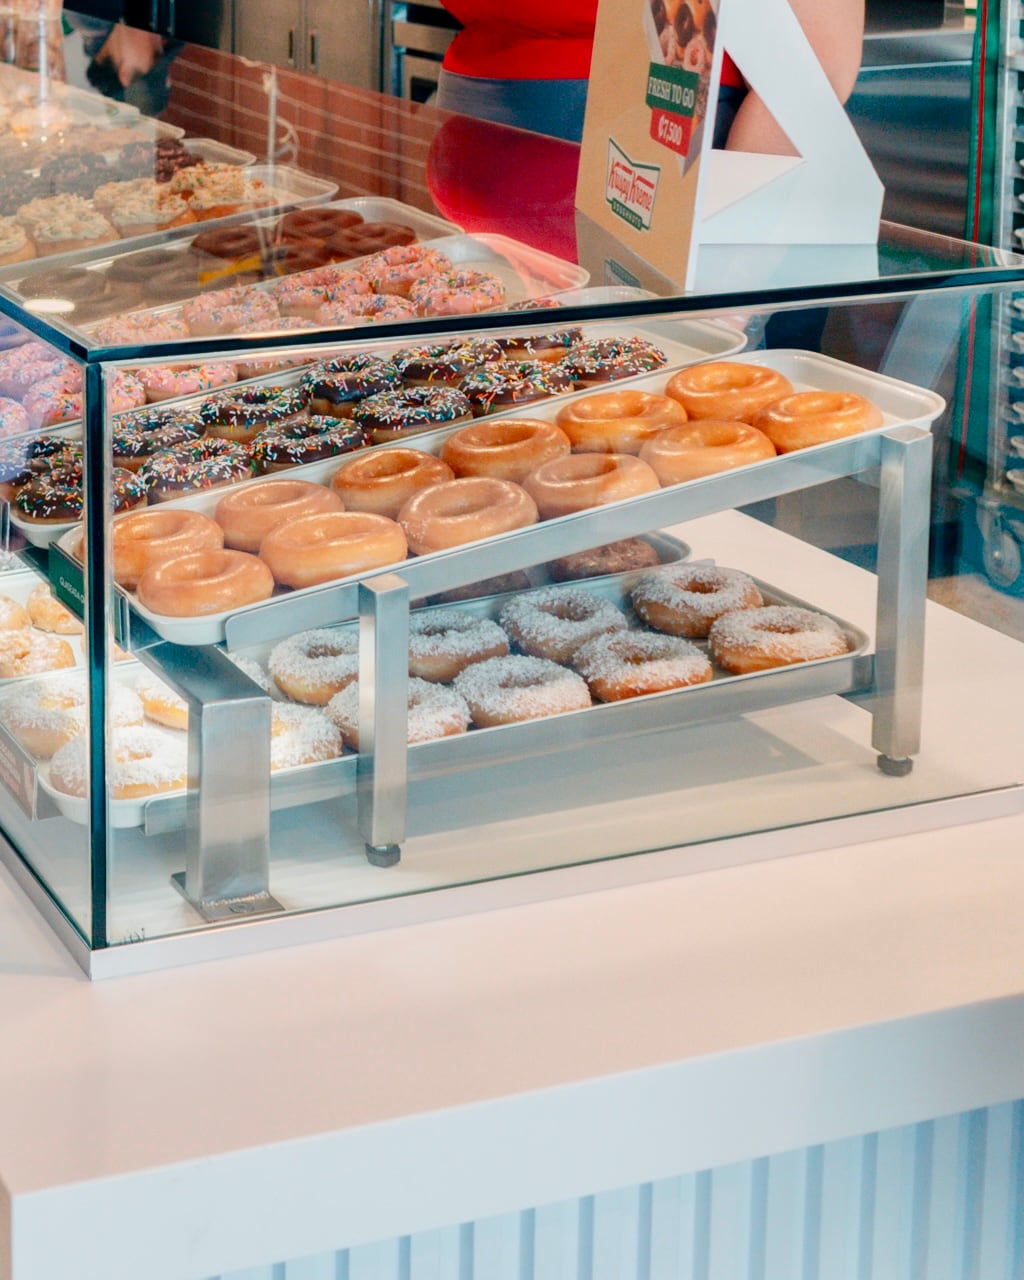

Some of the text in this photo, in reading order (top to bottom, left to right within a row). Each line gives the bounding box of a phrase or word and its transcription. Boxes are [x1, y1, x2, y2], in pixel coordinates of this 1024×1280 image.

[648, 76, 695, 109] FRESH TO GO
[608, 158, 655, 212] Krispy Kreme
